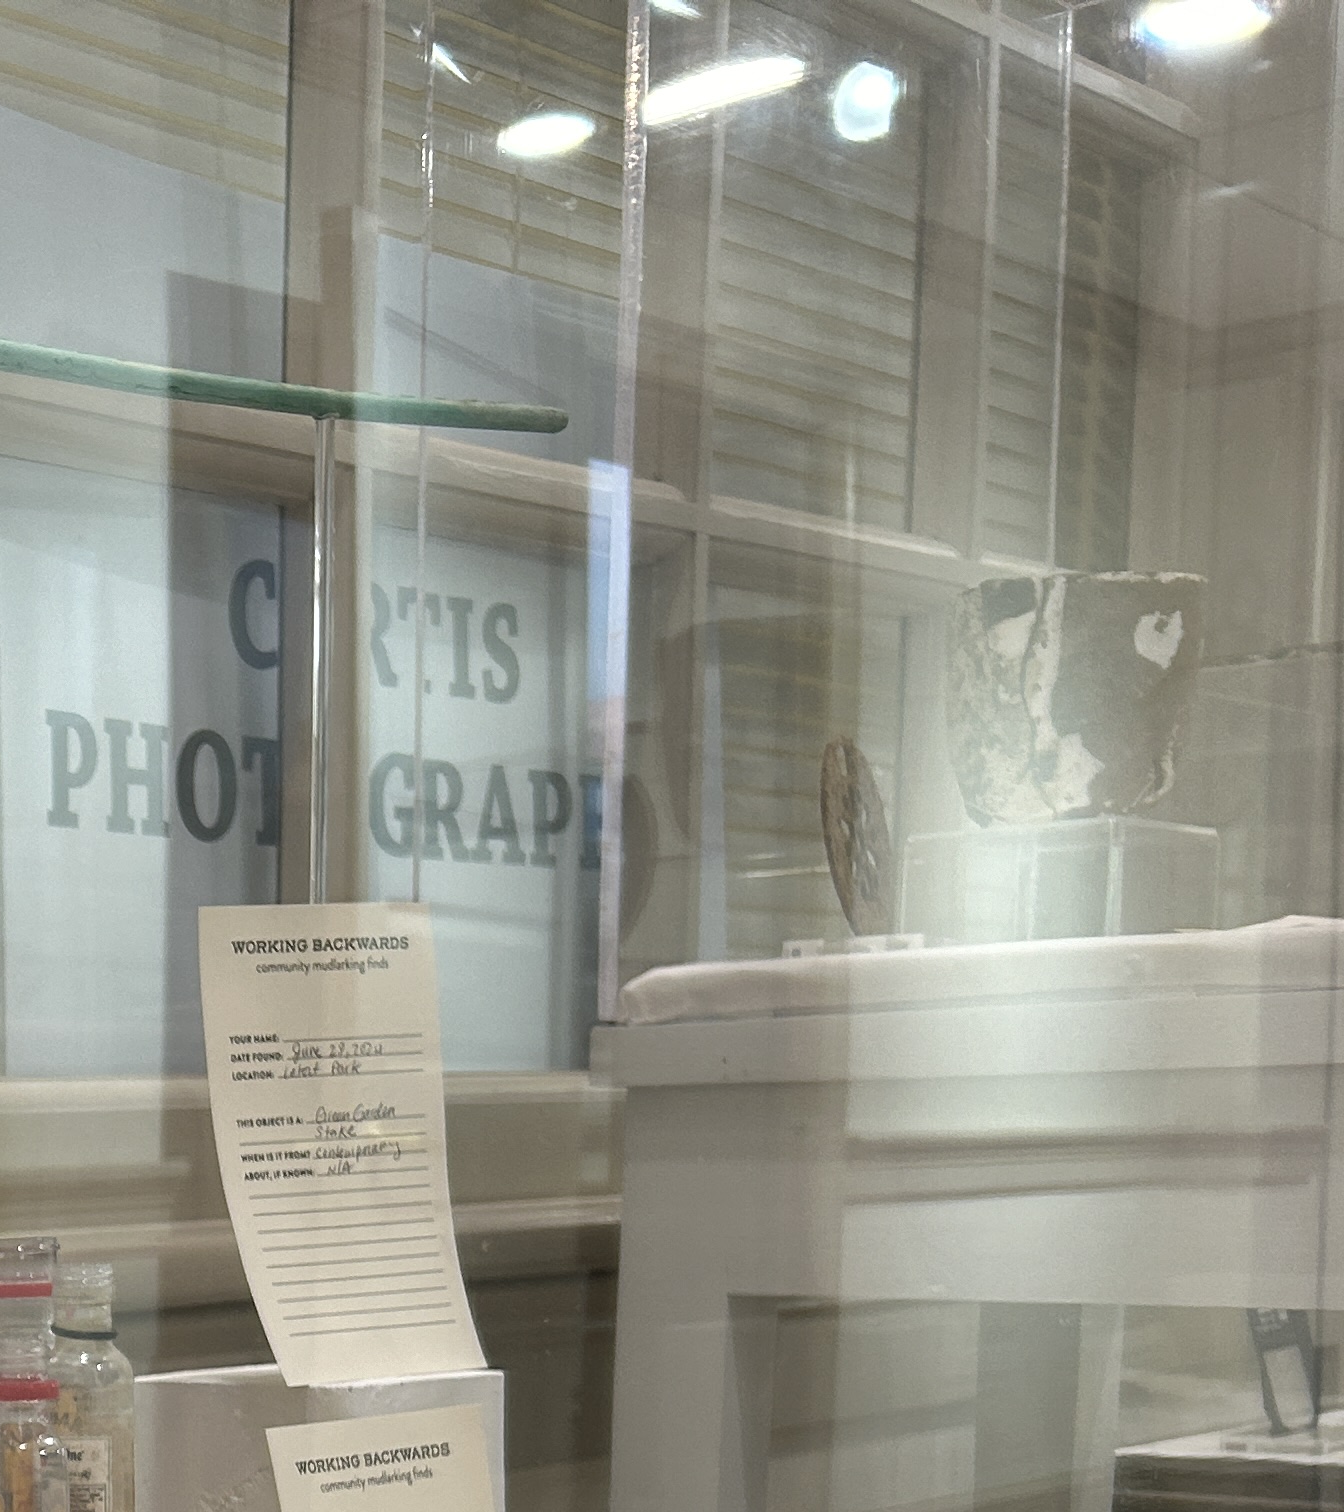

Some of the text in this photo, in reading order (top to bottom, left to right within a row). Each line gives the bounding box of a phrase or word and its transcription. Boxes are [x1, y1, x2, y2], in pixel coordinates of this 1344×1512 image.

[229, 558, 520, 704] CRTIS
[231, 937, 409, 954] WORKING BACKWARDS
[256, 956, 388, 975] community mudlarking finds
[295, 1442, 450, 1475] WORKING BACKWARDS
[320, 1476, 365, 1493] community
[367, 1470, 412, 1485] mudlarking
